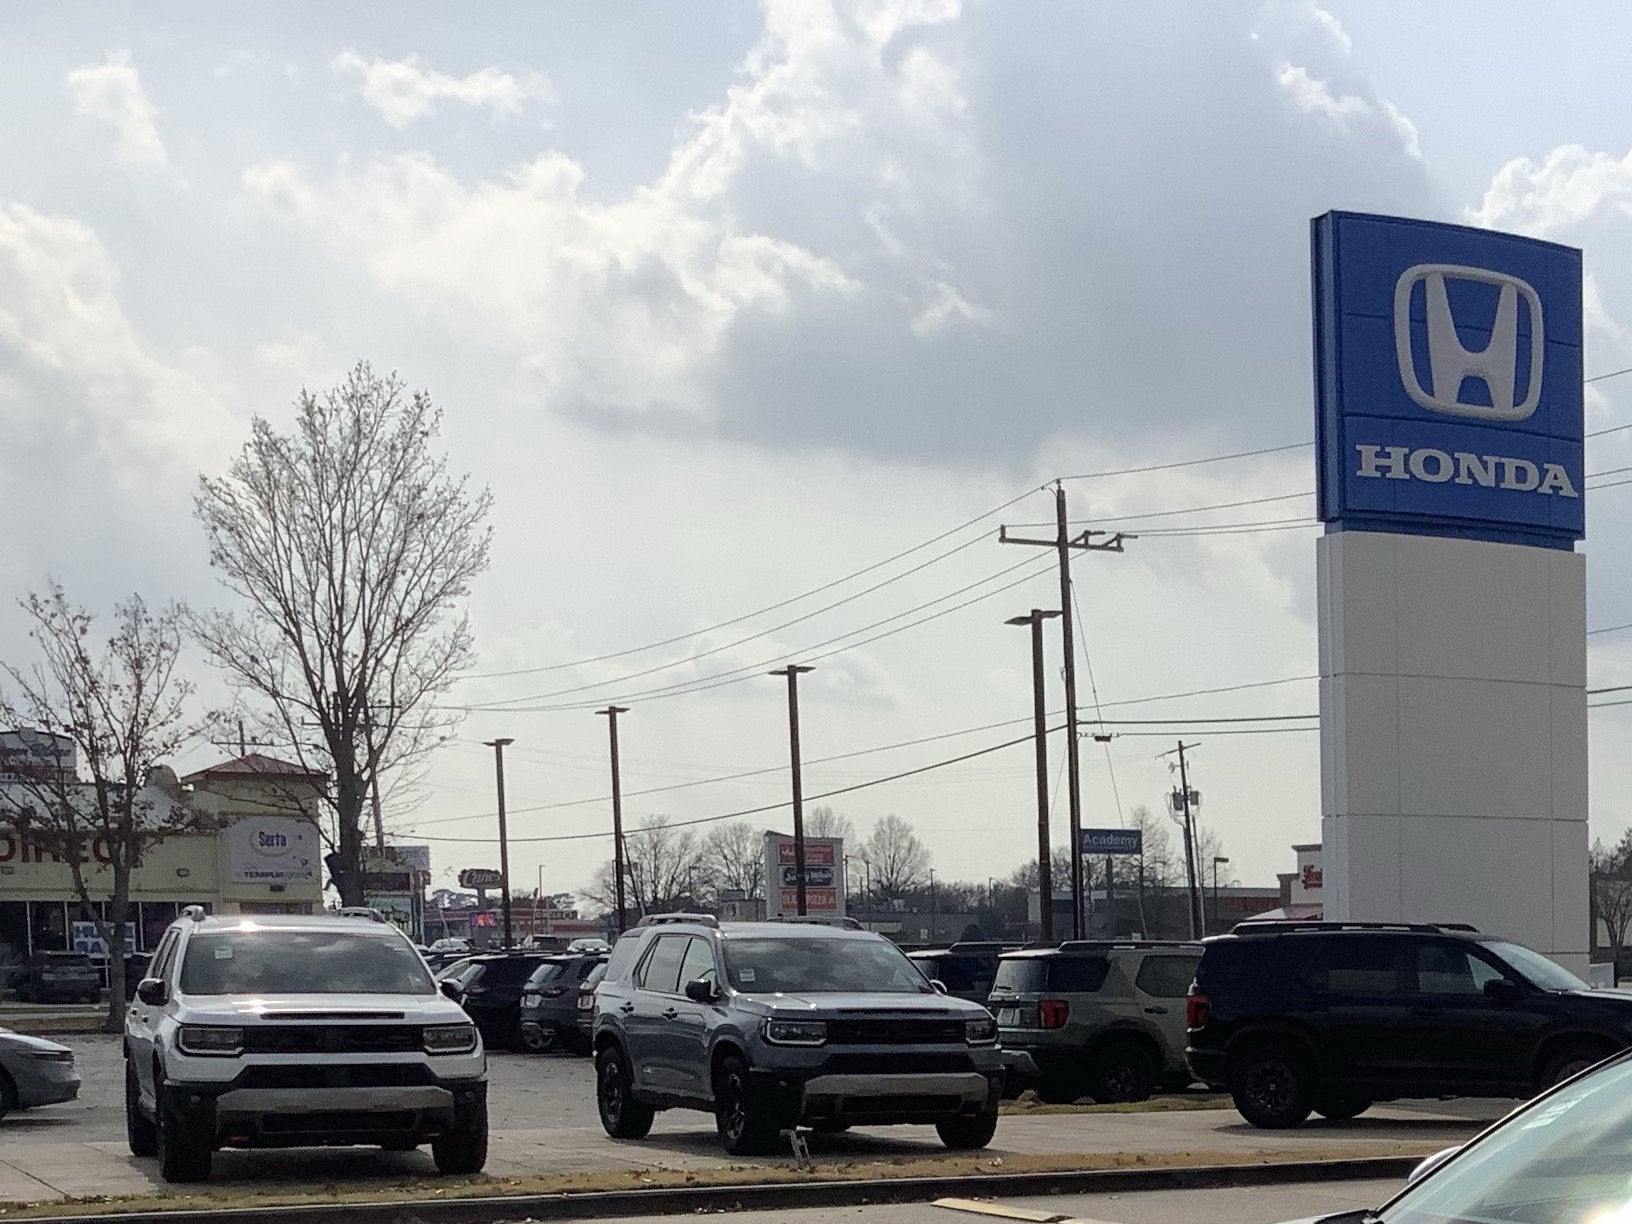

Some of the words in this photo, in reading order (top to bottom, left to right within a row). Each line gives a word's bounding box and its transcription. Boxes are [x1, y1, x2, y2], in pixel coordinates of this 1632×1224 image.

[1356, 444, 1579, 498] HONDA
[258, 831, 287, 847] Serta
[1083, 833, 1138, 849] Academy
